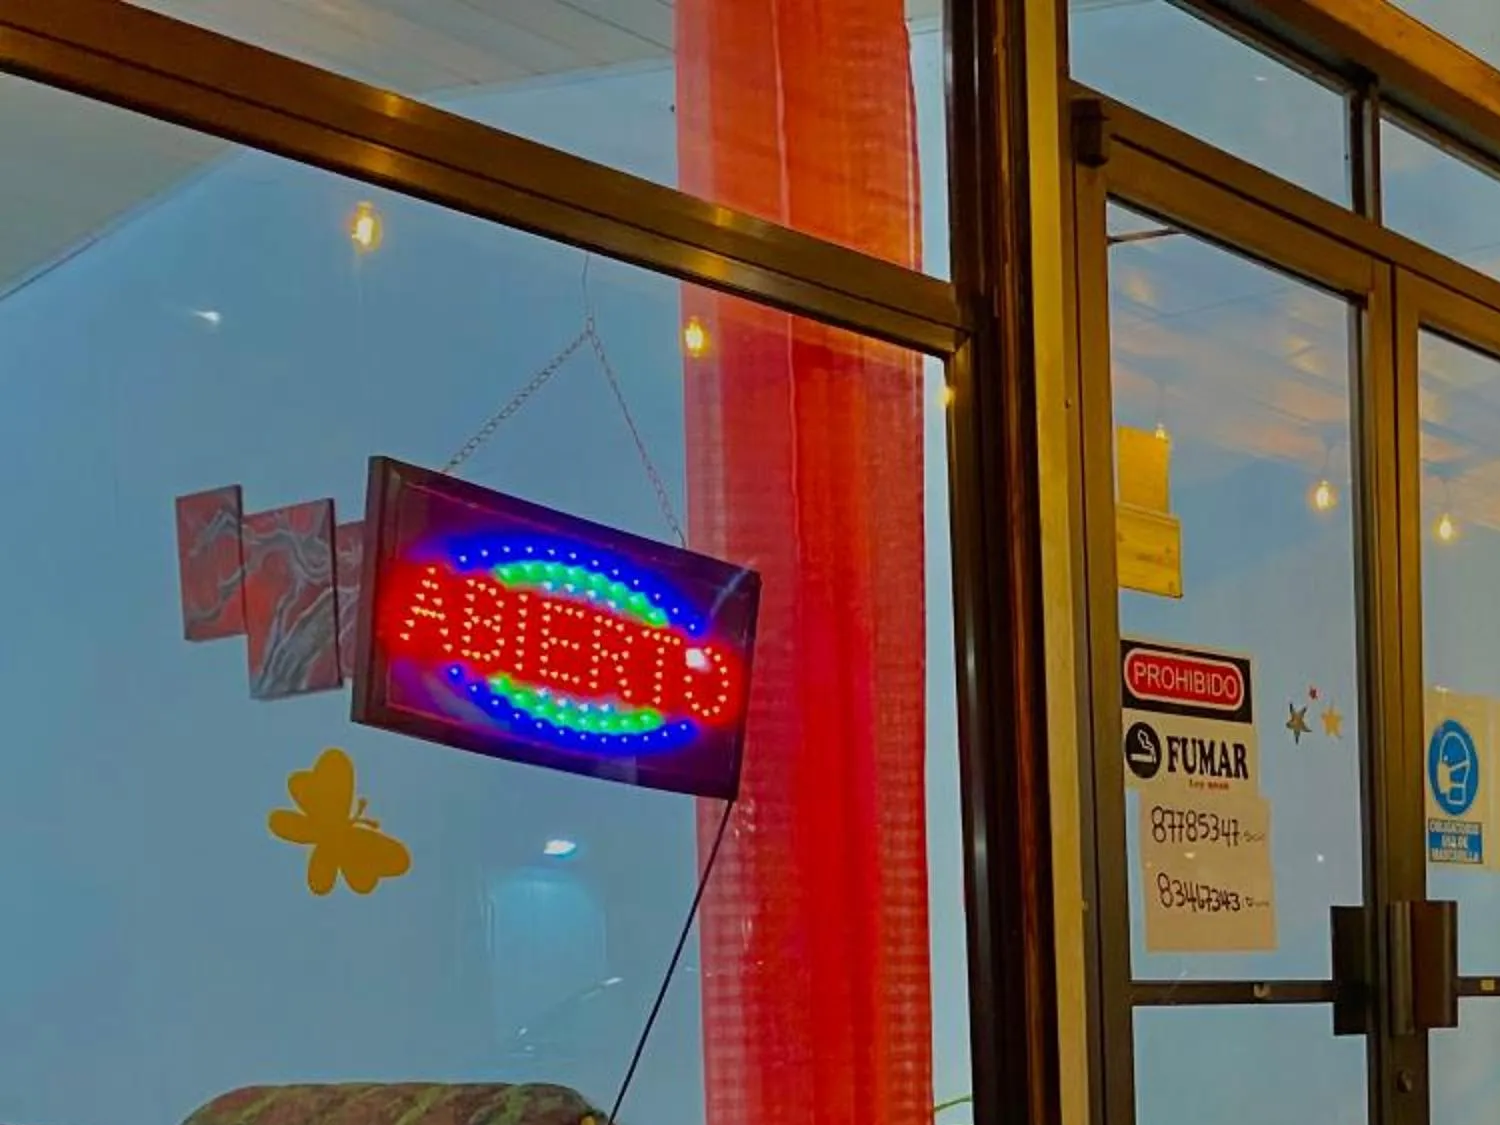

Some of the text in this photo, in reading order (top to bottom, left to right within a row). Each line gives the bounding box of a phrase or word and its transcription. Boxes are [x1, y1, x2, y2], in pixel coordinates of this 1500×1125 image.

[400, 566, 730, 717] ABIERTO
[1132, 661, 1239, 699] PROHIBIDO
[1166, 735, 1249, 780] FUMAR
[1151, 805, 1241, 848] 87785347
